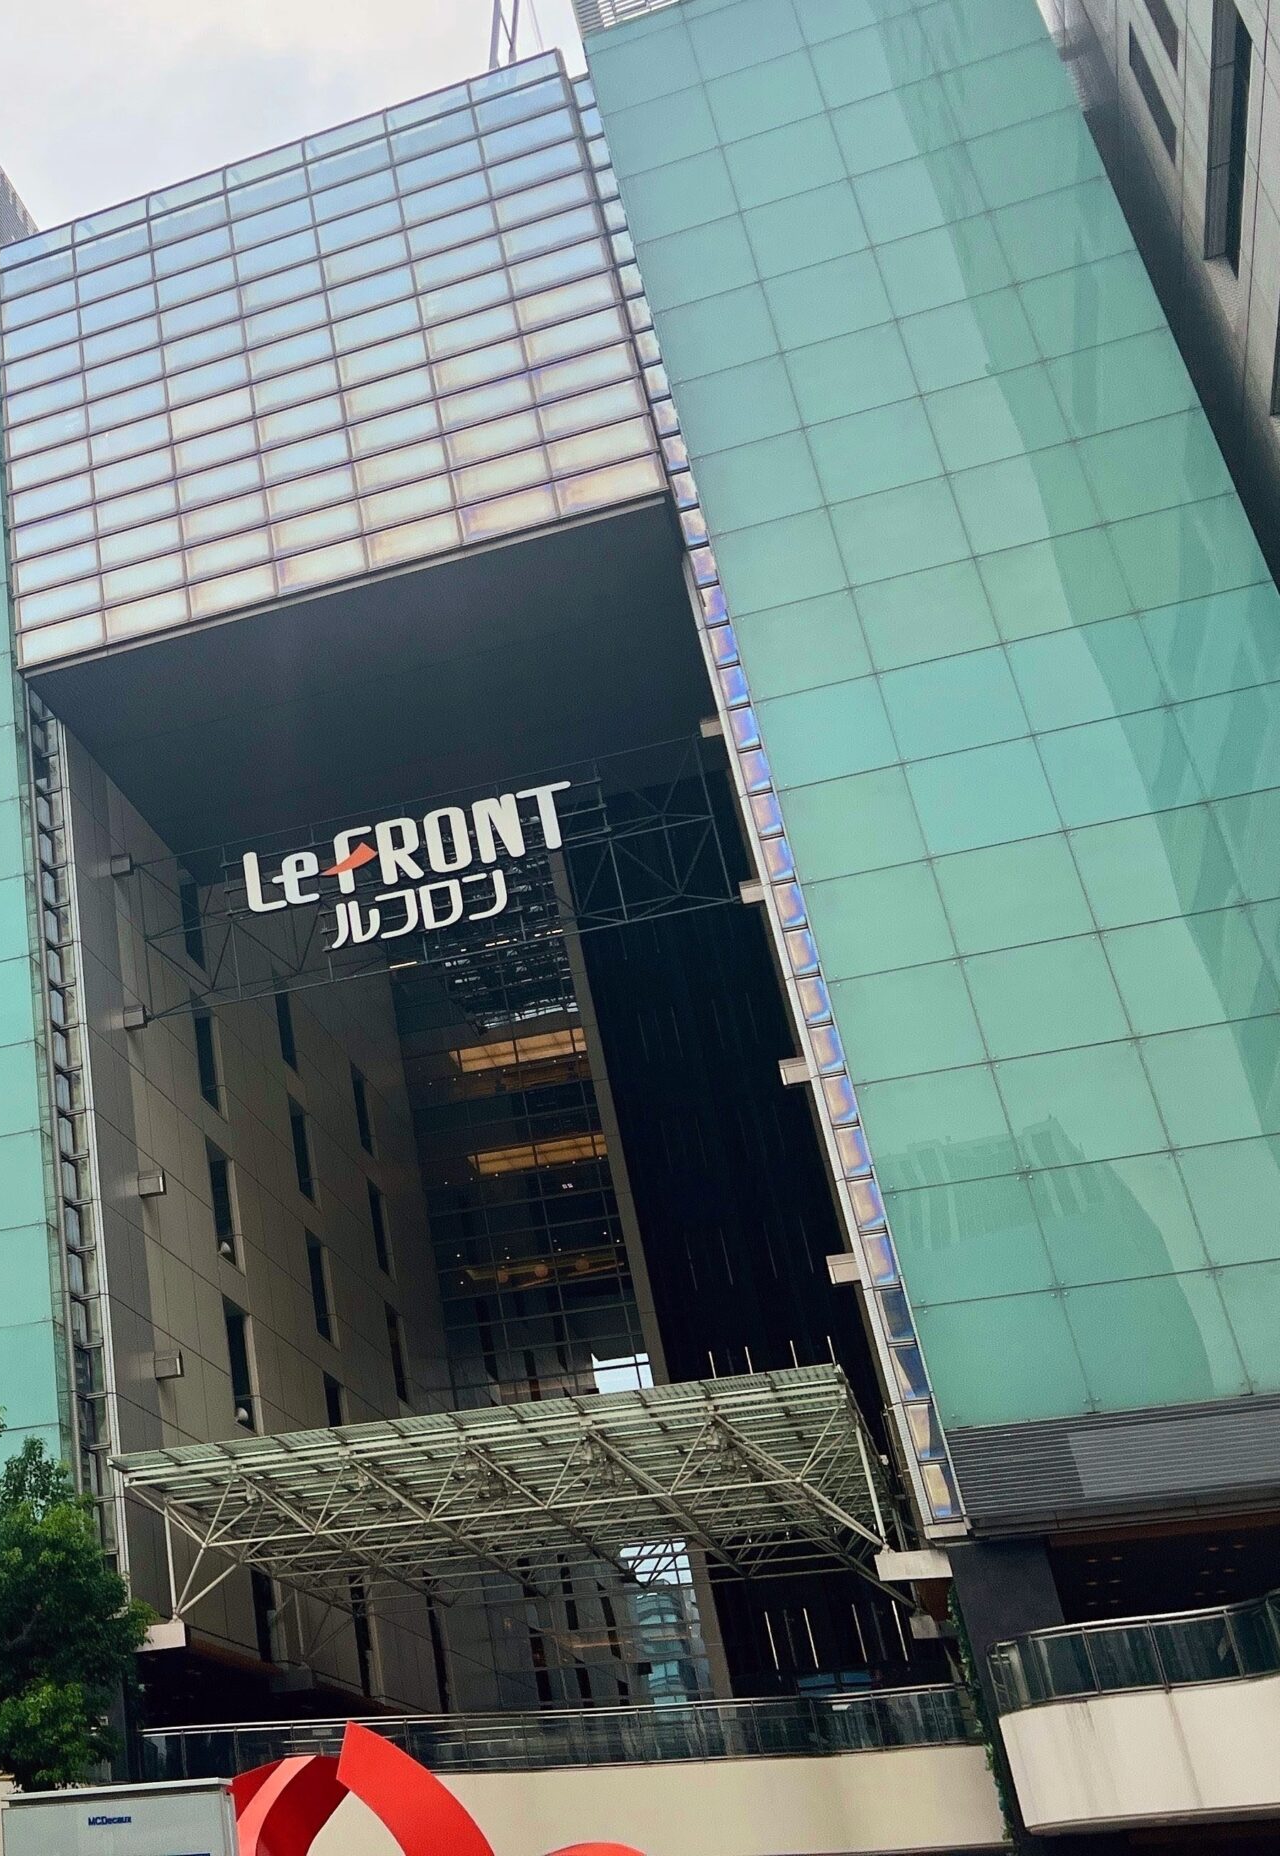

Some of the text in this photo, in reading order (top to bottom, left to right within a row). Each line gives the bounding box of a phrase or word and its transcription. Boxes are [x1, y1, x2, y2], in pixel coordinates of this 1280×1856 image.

[242, 780, 572, 913] Le FRONT
[330, 868, 508, 949] ルフロン
[87, 1815, 132, 1826] MCDecaux
